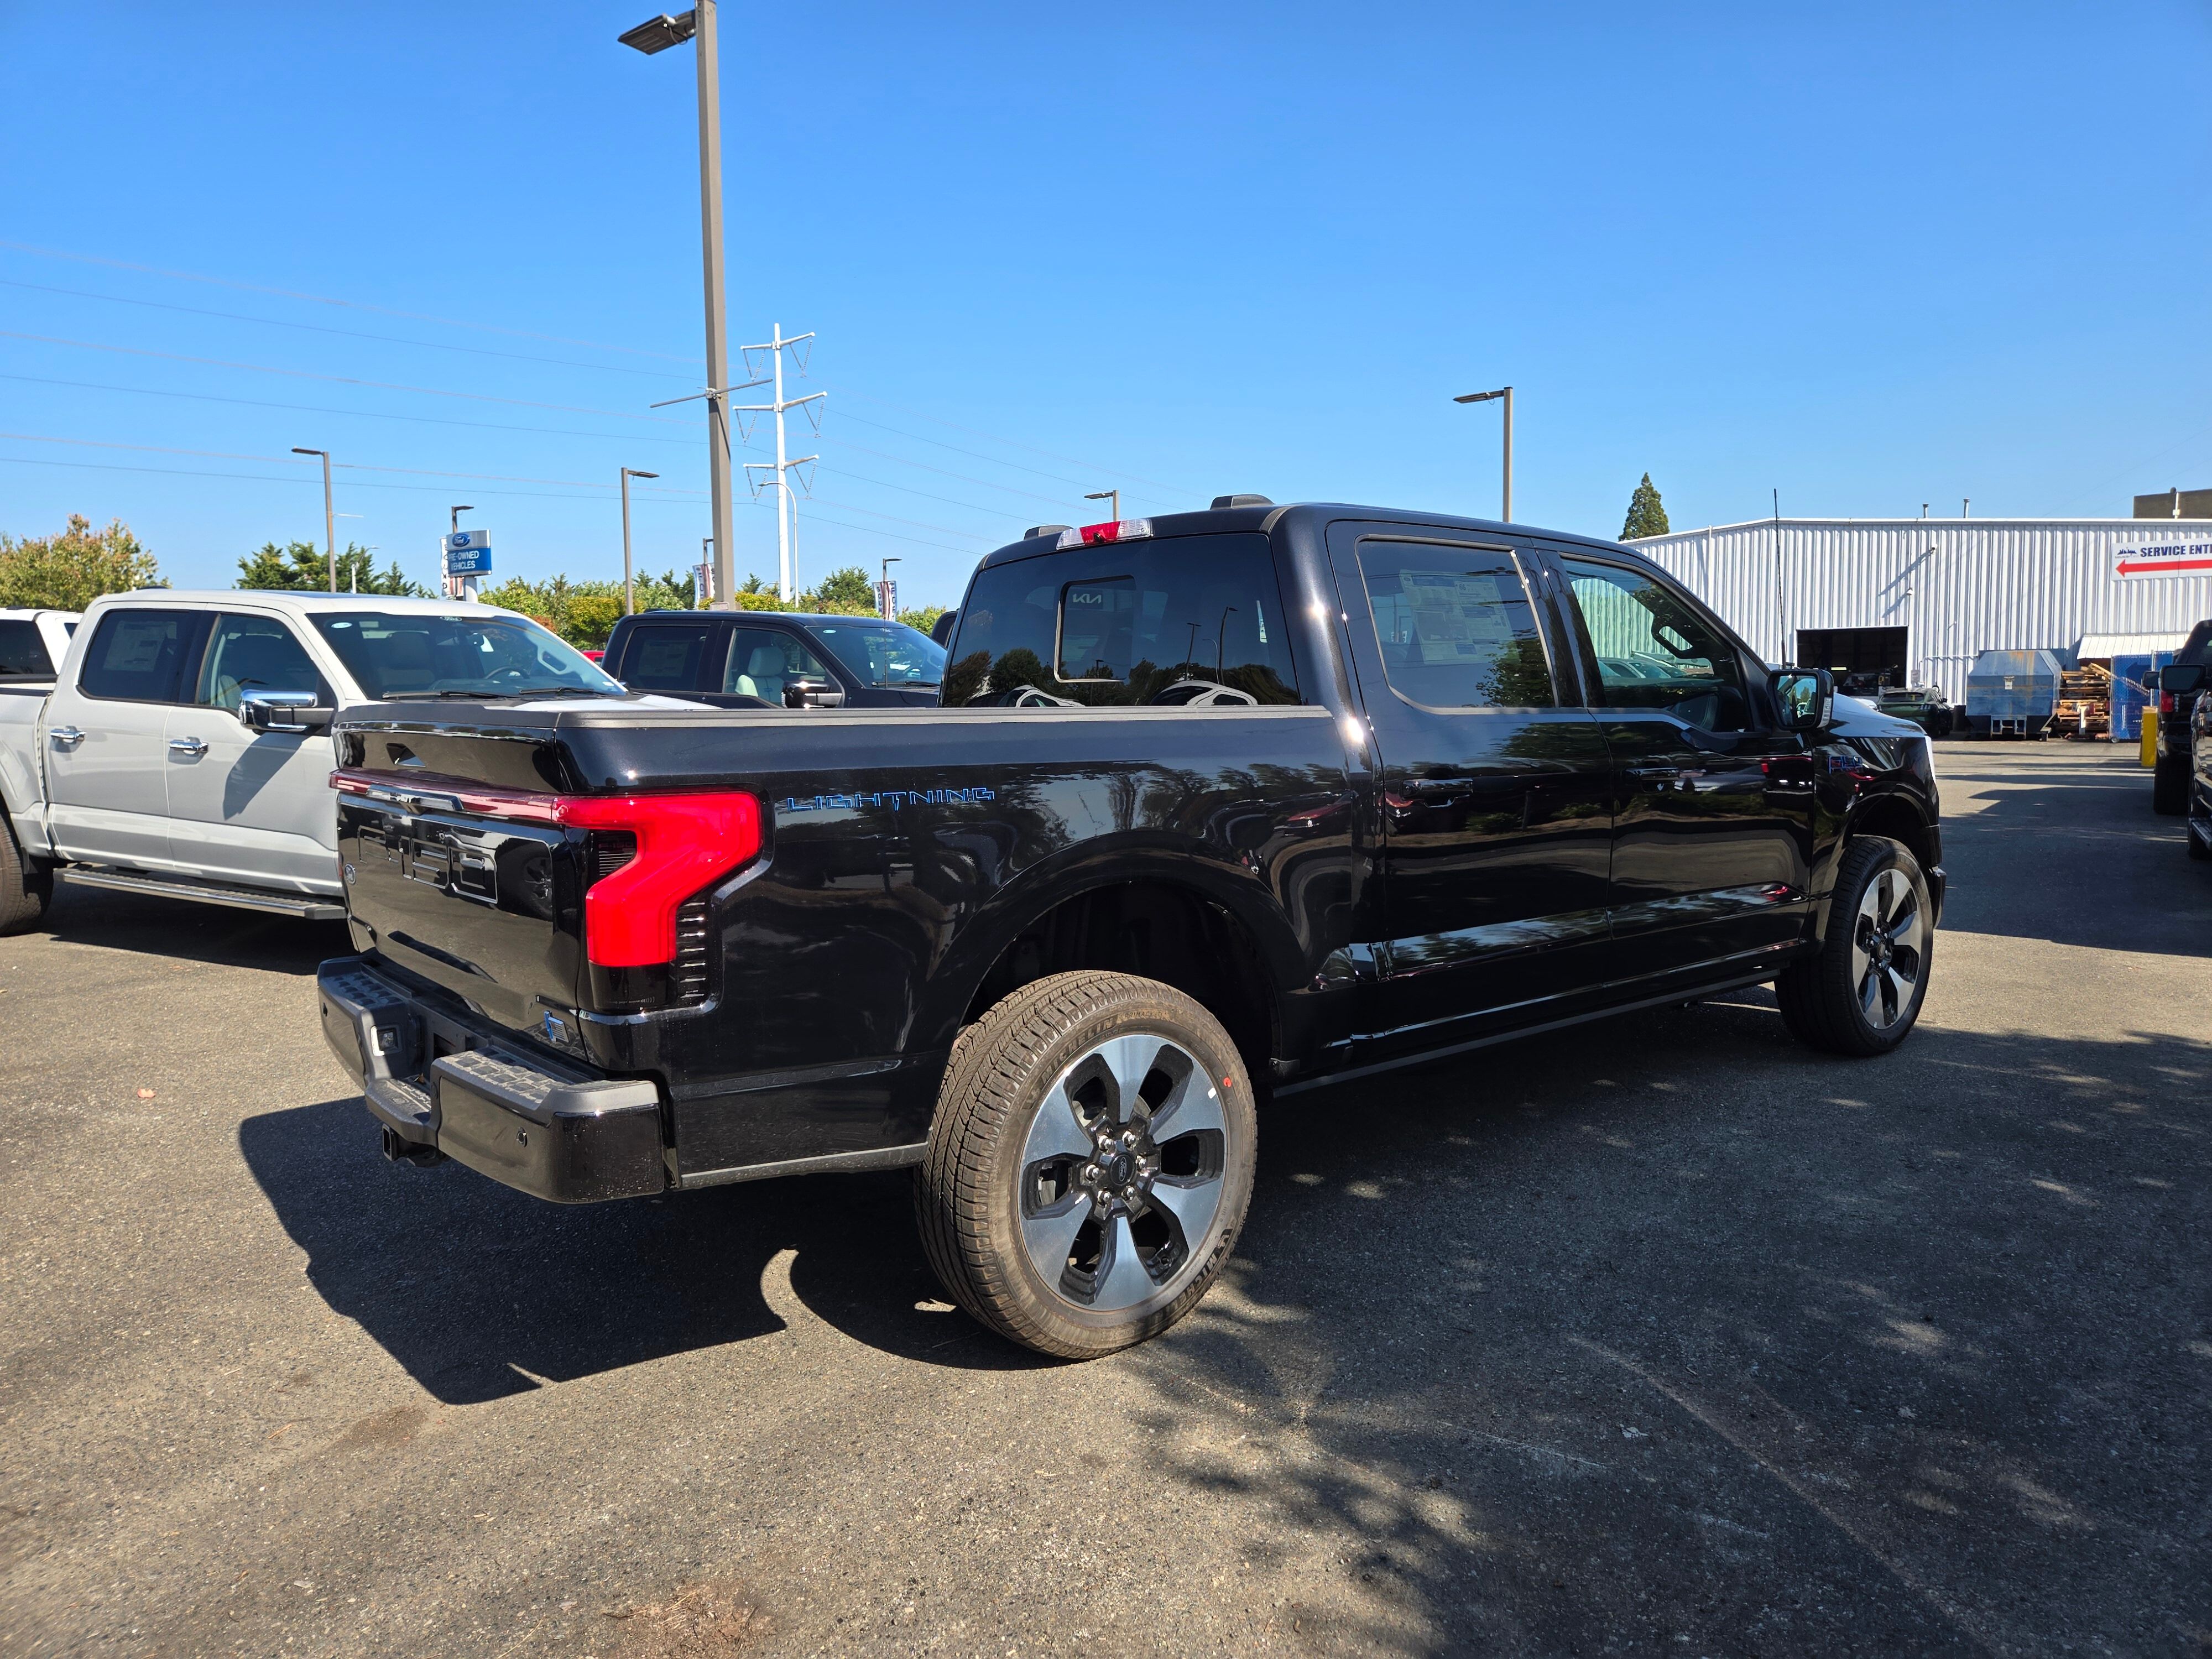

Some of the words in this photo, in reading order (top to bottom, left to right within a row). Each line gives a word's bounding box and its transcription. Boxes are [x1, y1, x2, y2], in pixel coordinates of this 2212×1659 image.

[2140, 545, 2186, 557] SERVICE
[2189, 544, 2212, 555] ENT
[451, 561, 476, 571] VEHICLES
[787, 787, 995, 811] LIGHTNING
[1039, 1014, 1119, 1085] MICHELIN
